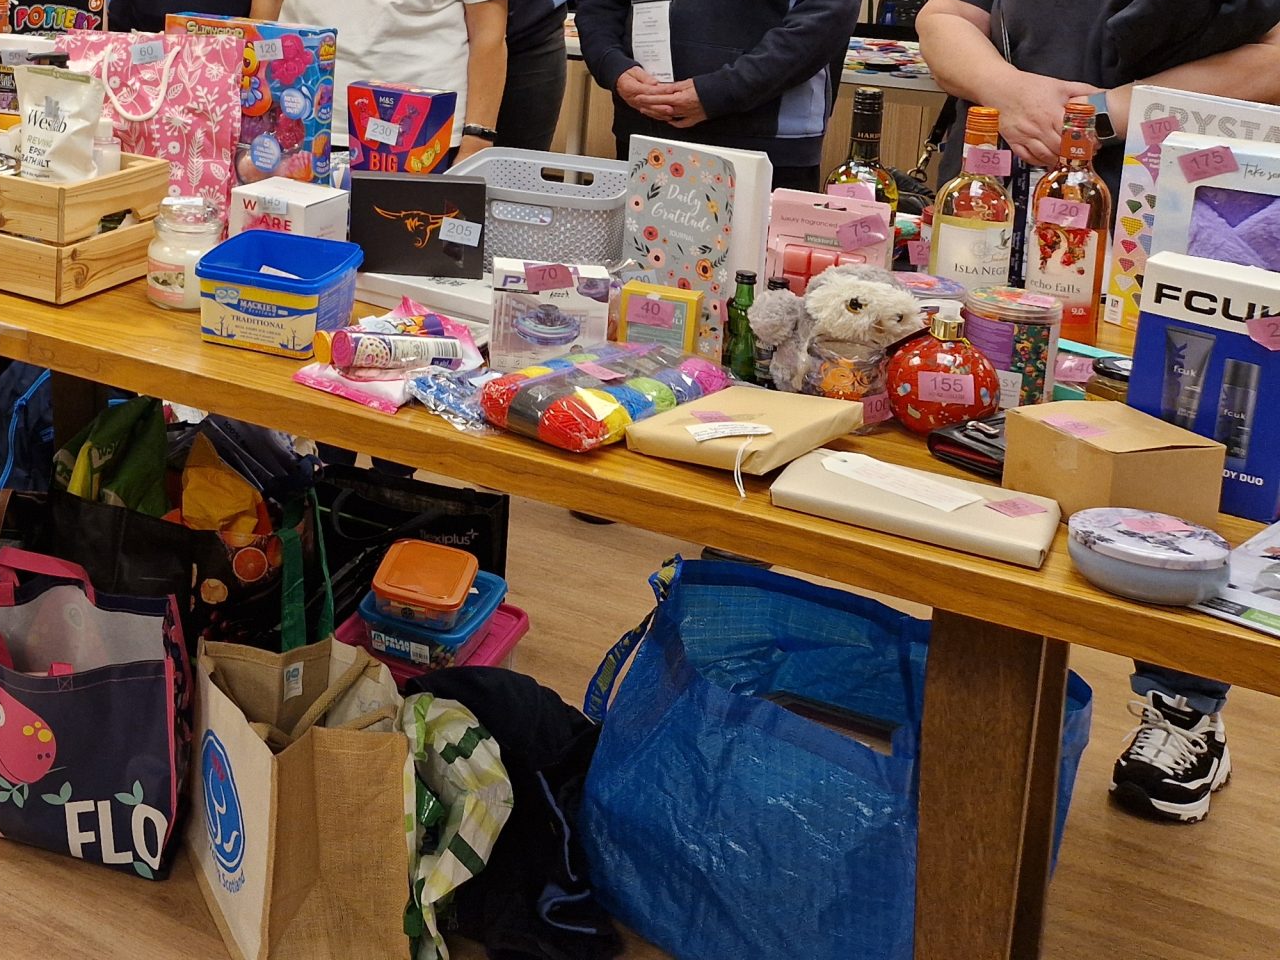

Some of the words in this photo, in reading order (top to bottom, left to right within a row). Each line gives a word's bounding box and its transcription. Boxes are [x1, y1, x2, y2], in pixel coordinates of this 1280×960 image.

[14, 6, 102, 31] POTTERY
[139, 45, 154, 57] 60
[259, 42, 277, 54] 120
[379, 96, 394, 105] M&S
[371, 122, 392, 137] 230
[1148, 120, 1171, 134] 170
[369, 150, 398, 173] BIG
[980, 152, 1001, 166] 55
[1191, 151, 1224, 170] 175
[666, 184, 701, 216] Daily
[651, 201, 712, 233] Gratitude
[1049, 202, 1080, 218] 120
[260, 213, 293, 232] ARE
[447, 222, 473, 238] 205
[780, 216, 799, 225] luxury
[800, 218, 839, 229] fragranced
[848, 220, 872, 238] 75
[538, 267, 558, 281] 70
[954, 263, 979, 275] ISLA
[1029, 279, 1052, 290] echo
[1055, 281, 1081, 294] falls
[640, 302, 661, 316] 40
[231, 314, 287, 330] TRADITIONAL
[1173, 364, 1199, 378] fcuk
[930, 378, 963, 392] 155
[1223, 409, 1247, 420] fcuk
[1239, 472, 1264, 487] DUO
[222, 868, 247, 893] Scotland
